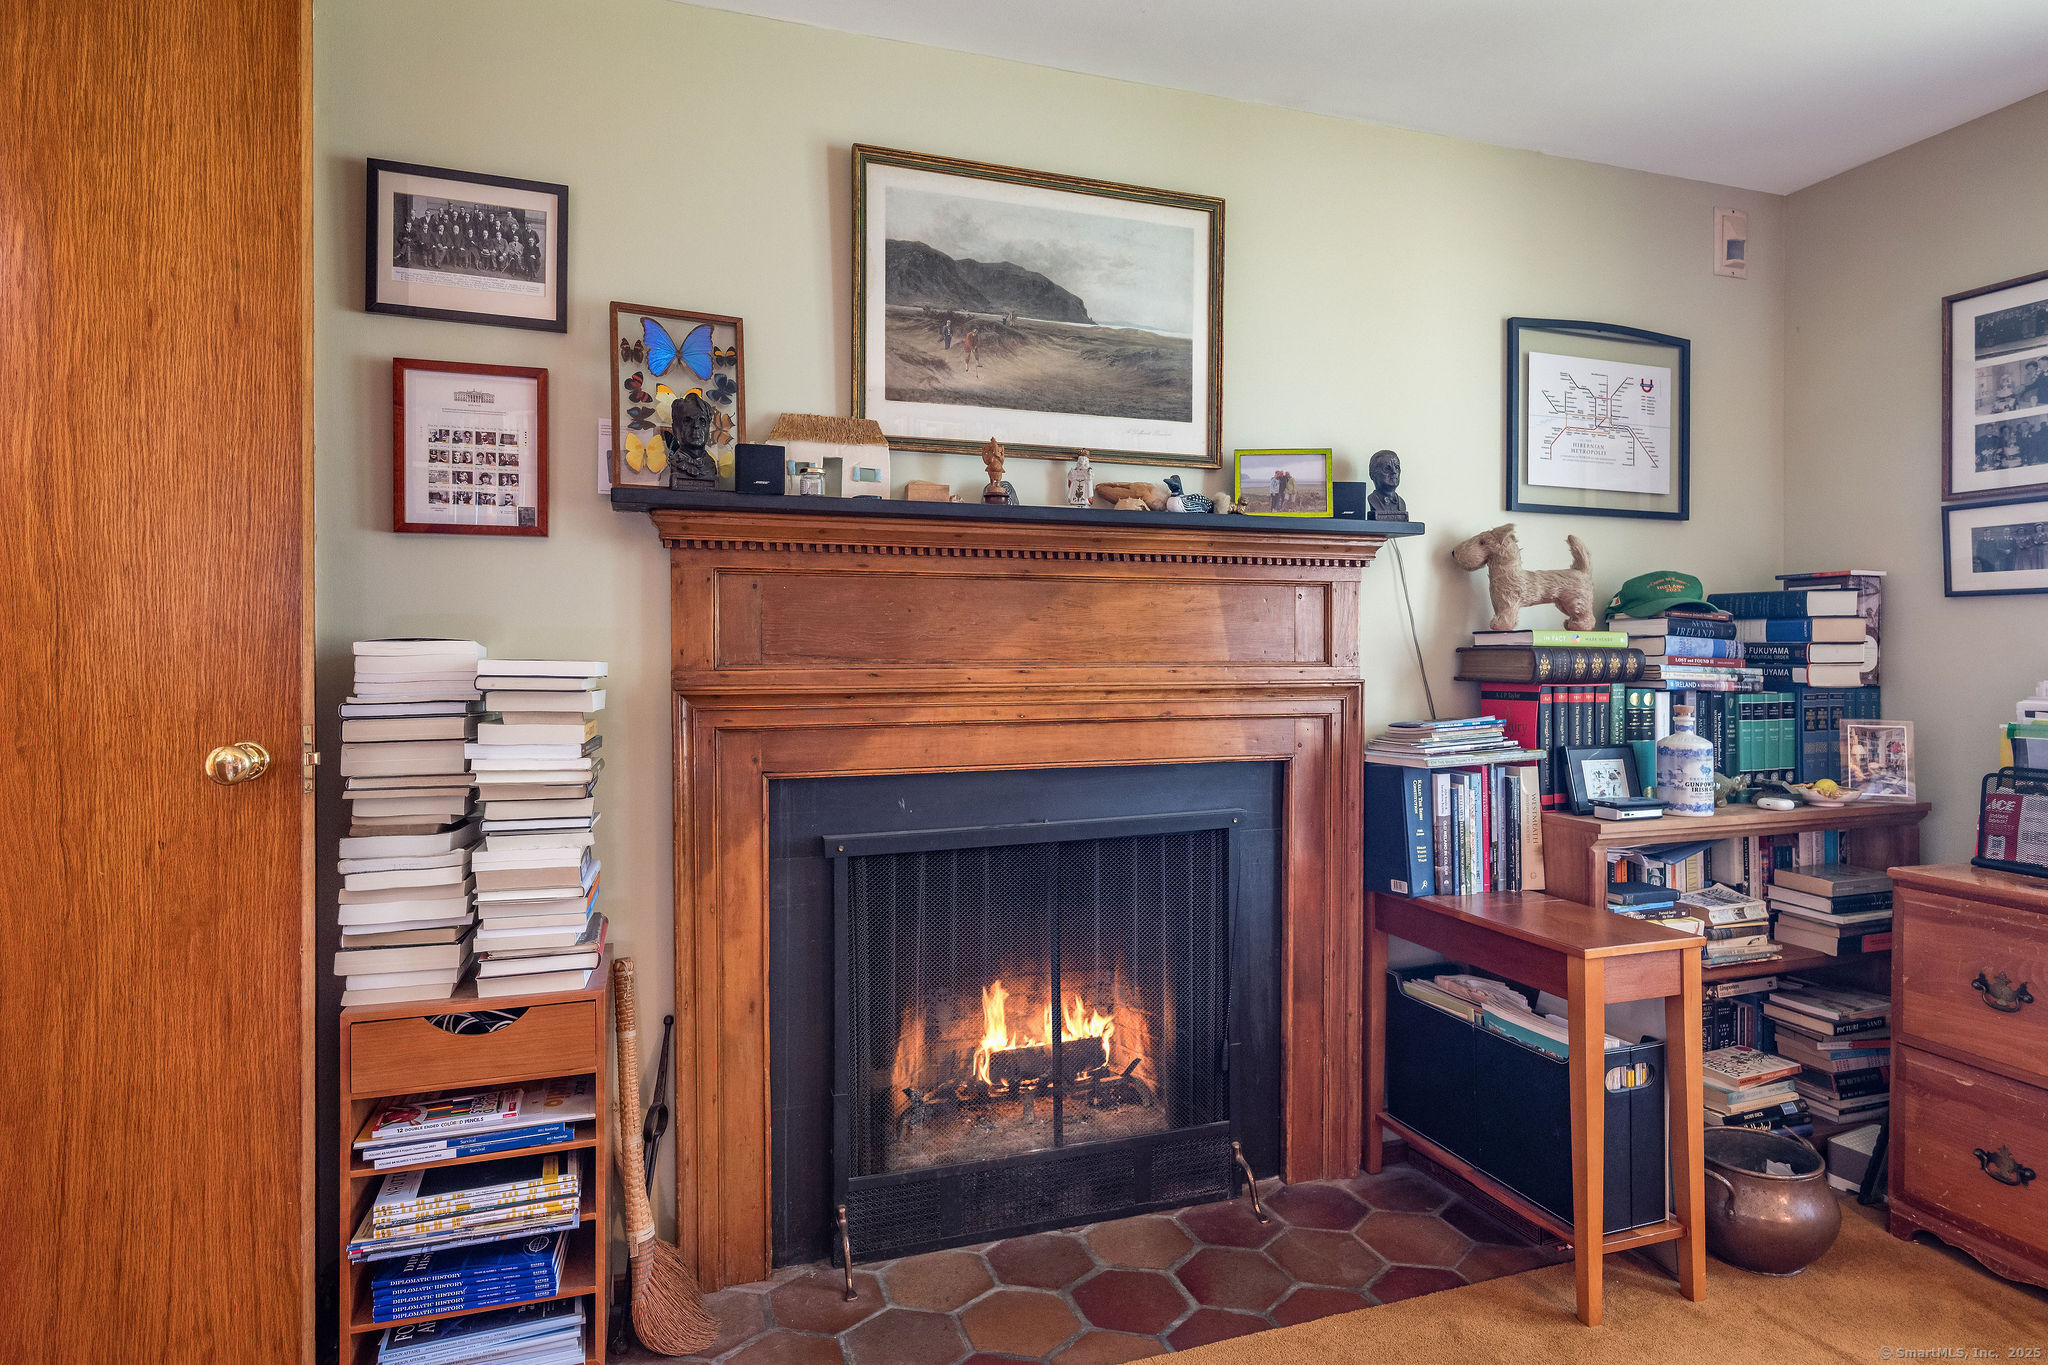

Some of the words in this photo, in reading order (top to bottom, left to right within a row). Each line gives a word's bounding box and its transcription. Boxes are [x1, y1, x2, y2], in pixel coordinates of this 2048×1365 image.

[1572, 442, 1605, 450] HIBERNIAN
[1676, 627, 1715, 638] IRELAND
[1748, 647, 1789, 655] FUKUYAMA
[1763, 668, 1789, 676] UYAMA
[1986, 798, 2017, 812] ACE
[1531, 793, 1540, 845] WESTMEATH
[440, 1119, 464, 1128] COLORED
[464, 1117, 484, 1125] PENCILS
[390, 1276, 431, 1286] DIPLOMATIC
[432, 1272, 462, 1281] HISTORY
[392, 1285, 434, 1295] DIPLOMATIC
[434, 1281, 464, 1290] HISTORY
[392, 1294, 434, 1305] DIPLOMATIC
[435, 1289, 465, 1298] HISTORY
[392, 1302, 434, 1313] DIPLOMATIC
[435, 1297, 465, 1306] HISTORY
[392, 1310, 434, 1320] DIPLOMATIC
[435, 1304, 465, 1313] HISTORY
[383, 1352, 403, 1360] FOREIGN
[403, 1348, 421, 1356] AFFAIRS
